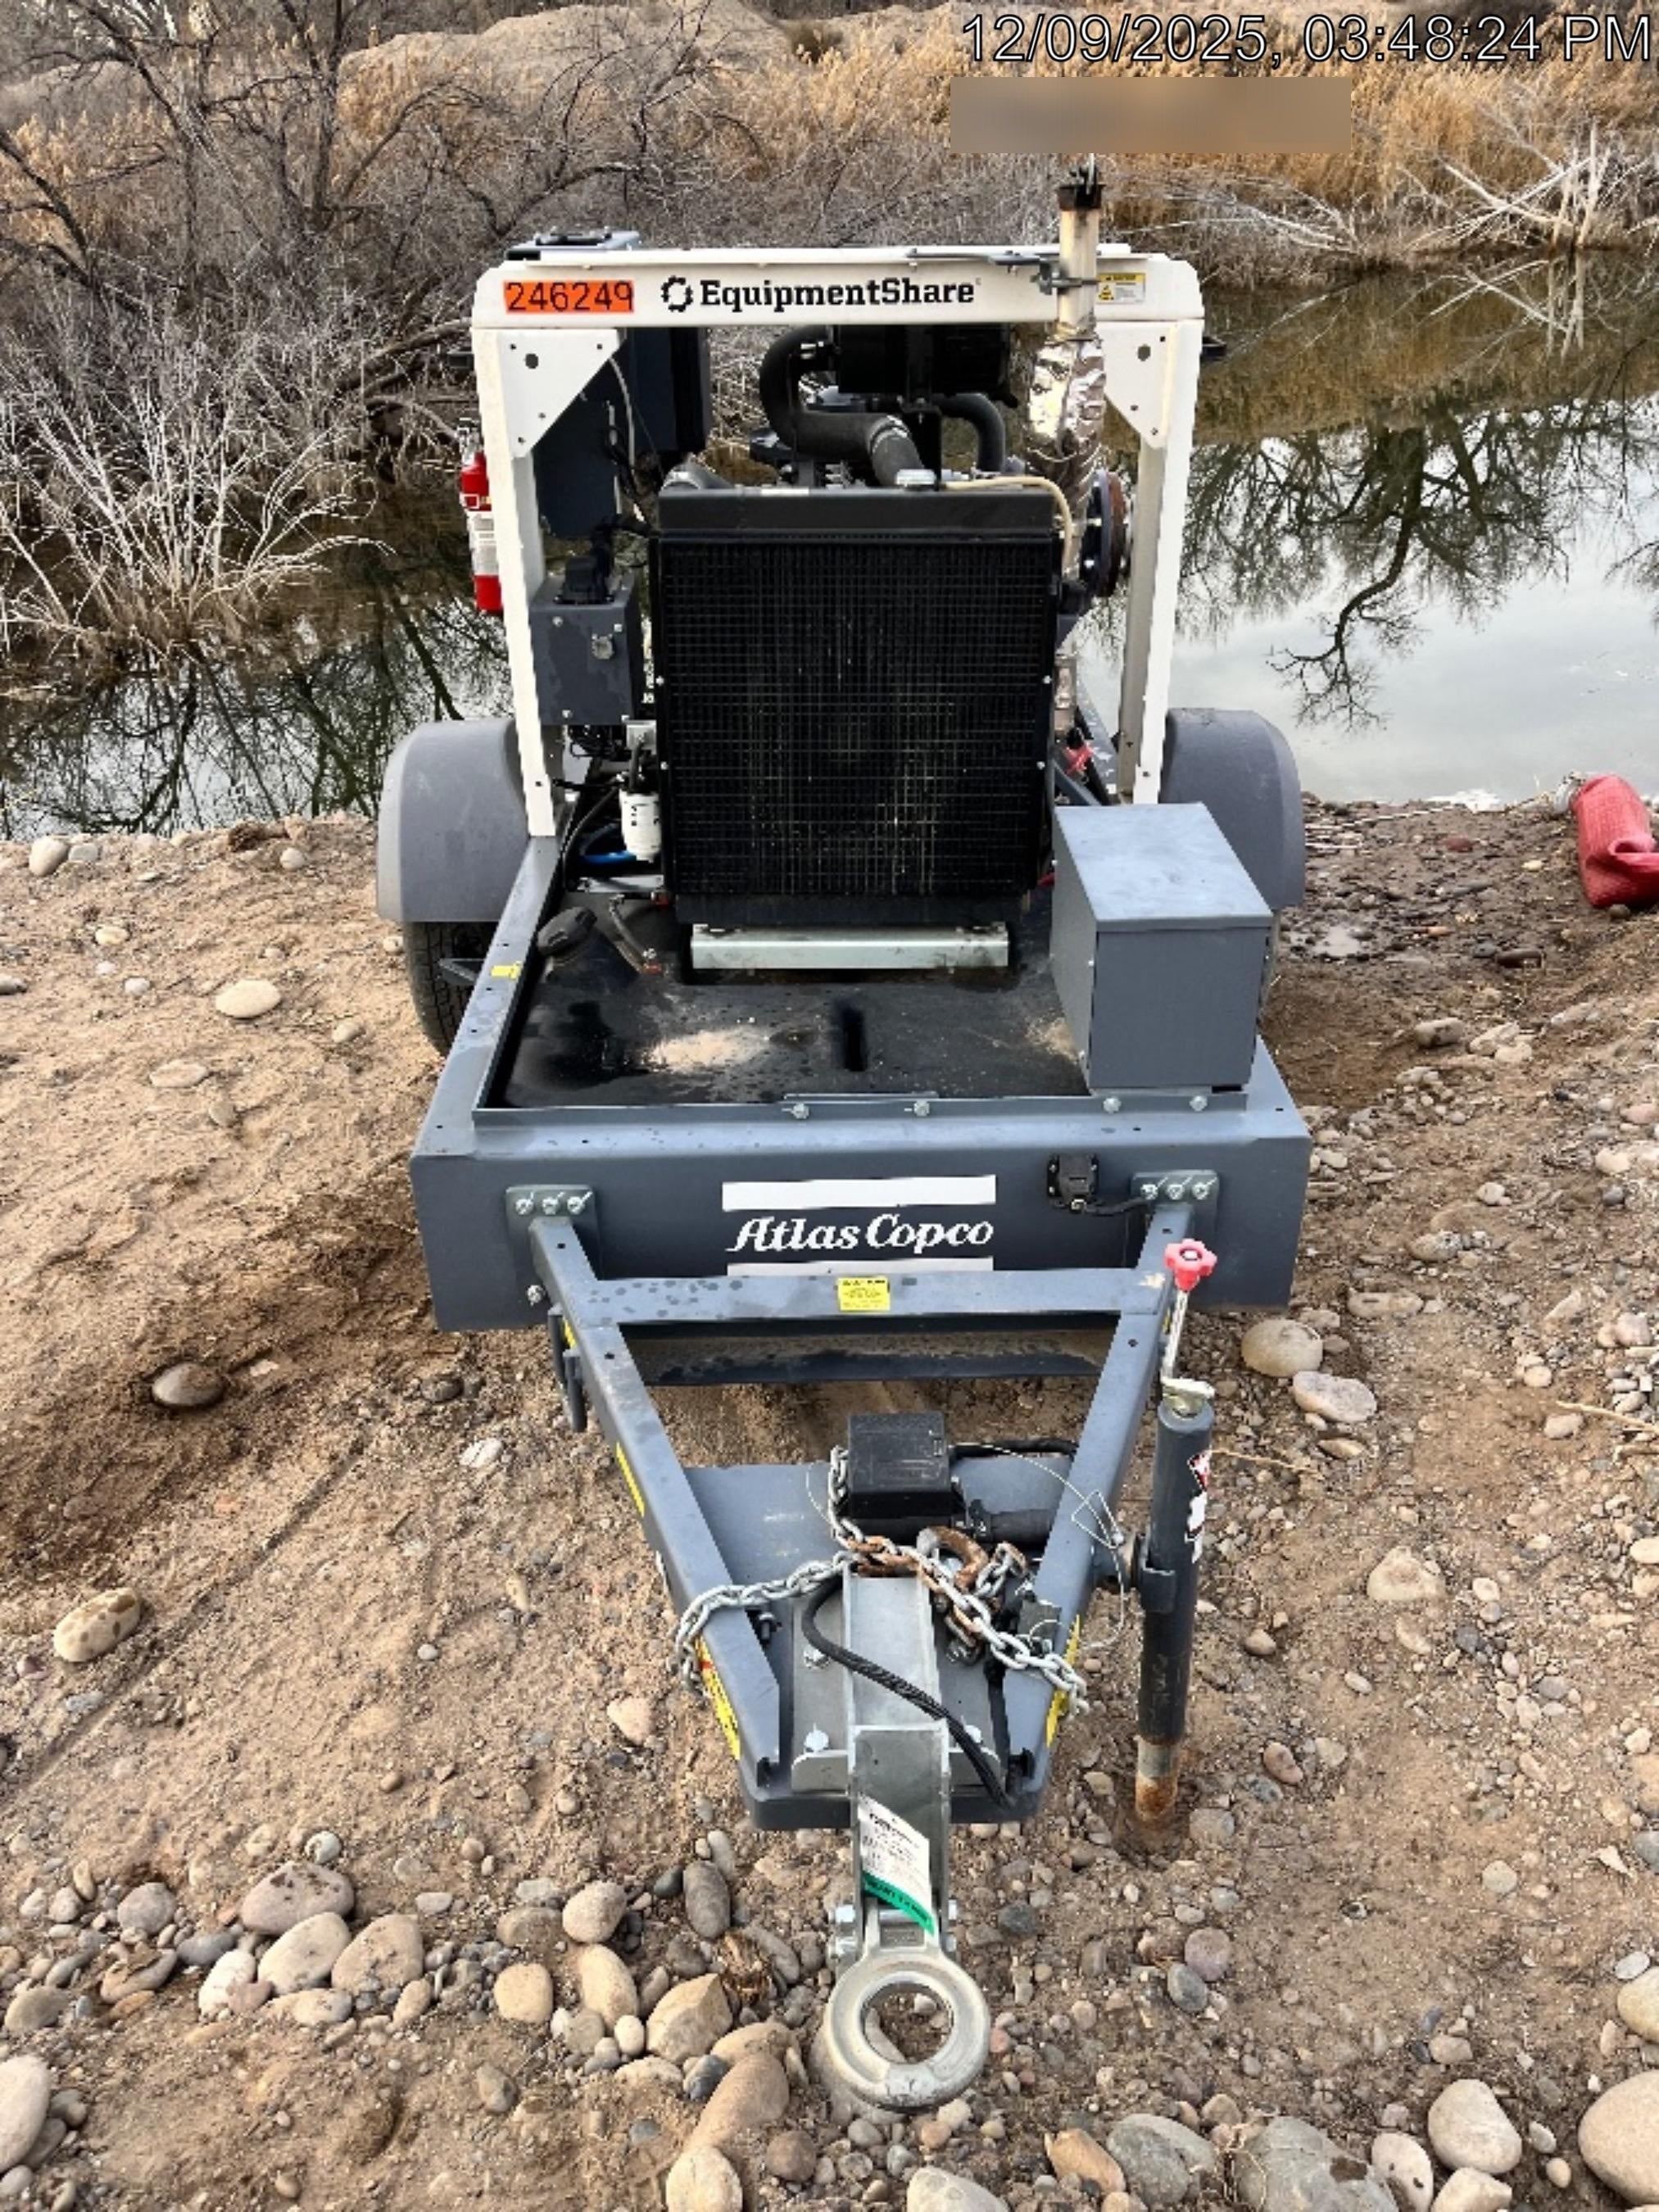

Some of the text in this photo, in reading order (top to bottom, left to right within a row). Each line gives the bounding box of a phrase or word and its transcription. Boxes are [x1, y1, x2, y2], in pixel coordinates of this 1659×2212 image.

[507, 281, 632, 311] 246249
[700, 279, 974, 312] EquipmentShare
[726, 1213, 993, 1254] Atlas Copco
